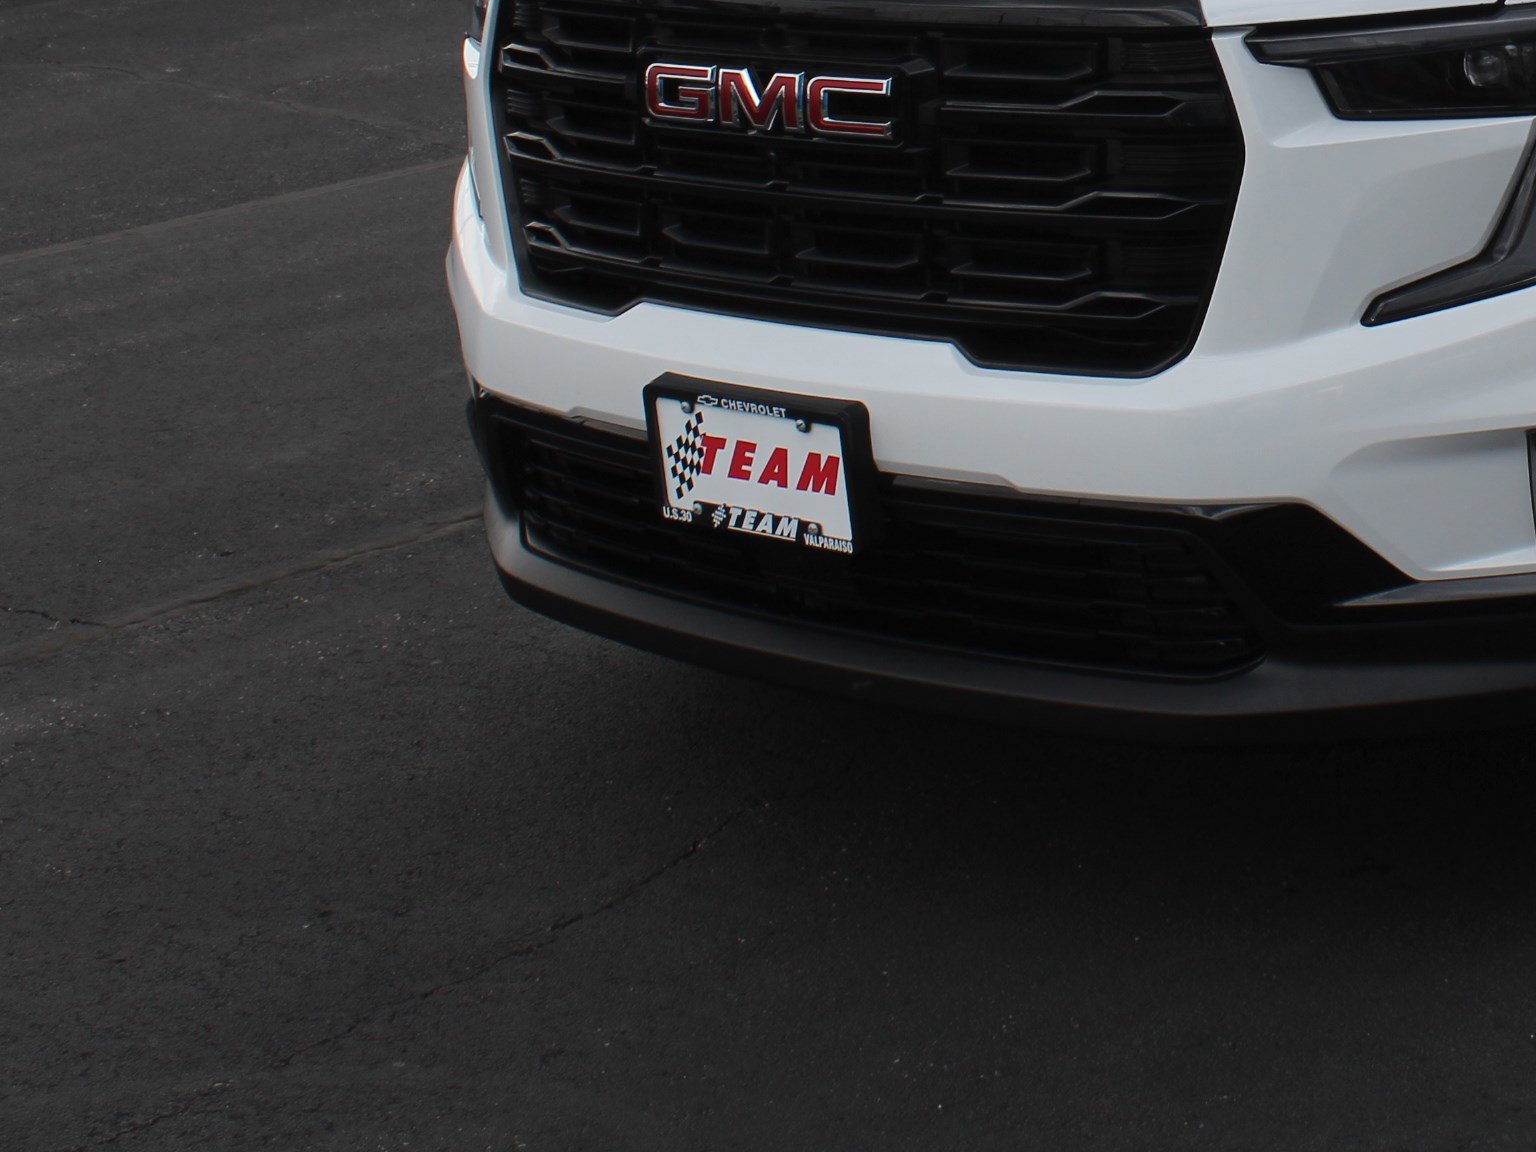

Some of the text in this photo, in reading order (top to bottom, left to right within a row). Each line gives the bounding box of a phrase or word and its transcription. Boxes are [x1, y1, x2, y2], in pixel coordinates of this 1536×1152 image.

[645, 62, 893, 140] GMC
[720, 398, 787, 418] CHEVROLET
[701, 434, 840, 496] TEAM
[728, 506, 800, 539] TEAM
[803, 533, 854, 554] VALPARAISO
